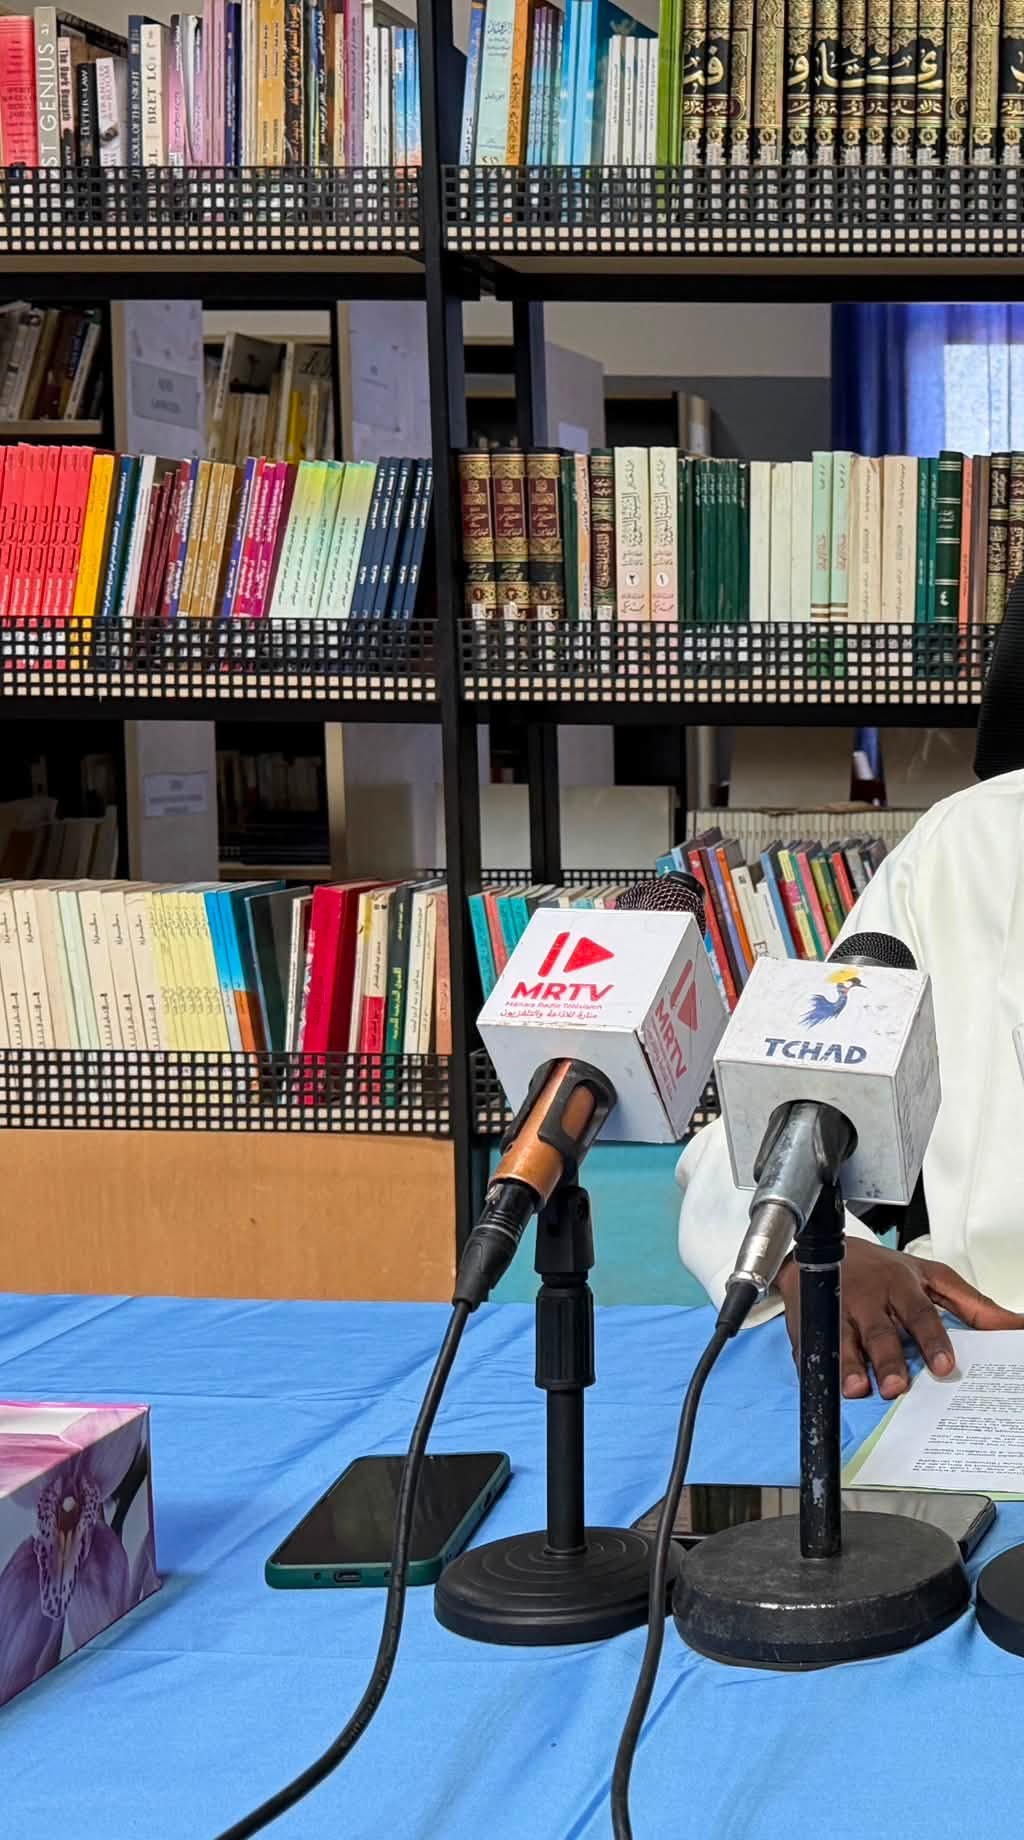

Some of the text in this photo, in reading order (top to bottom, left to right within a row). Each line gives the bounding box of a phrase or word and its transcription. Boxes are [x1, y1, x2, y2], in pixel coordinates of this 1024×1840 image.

[59, 49, 68, 64] The
[60, 66, 70, 86] Dark
[81, 69, 89, 91] LAW
[131, 70, 139, 99] NIGHT
[38, 44, 56, 167] ST GENIUS
[147, 88, 157, 124] BRET
[511, 982, 614, 1002] MRTV
[655, 997, 688, 1079] MRTV
[764, 1037, 867, 1065] TCHAD
